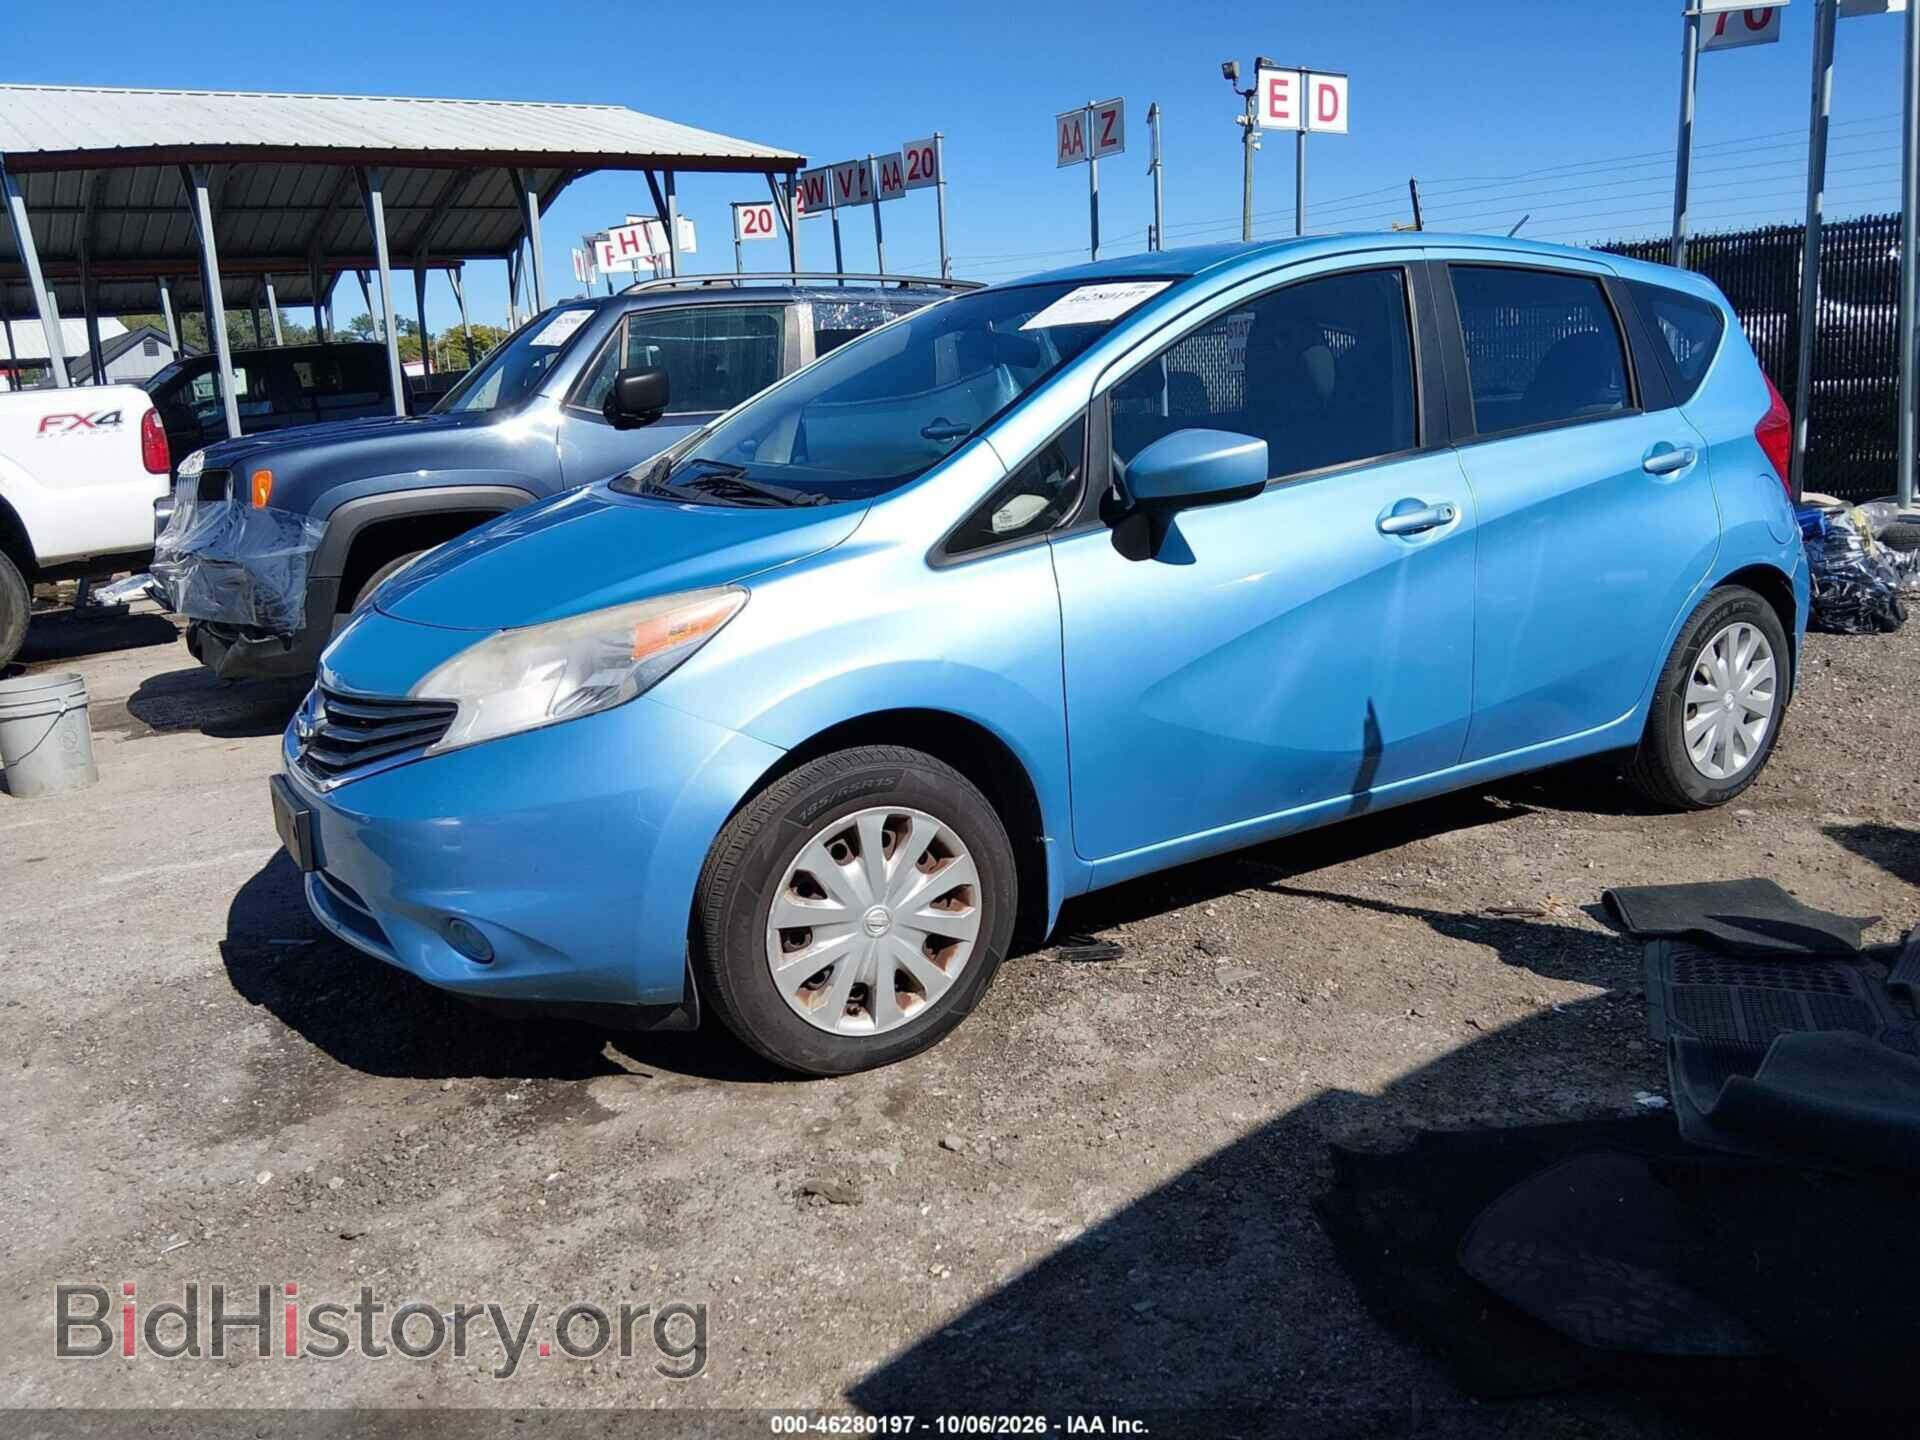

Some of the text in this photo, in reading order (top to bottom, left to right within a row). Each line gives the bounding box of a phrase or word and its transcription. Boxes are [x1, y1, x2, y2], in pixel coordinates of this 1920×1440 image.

[1269, 79, 1289, 118] E
[1318, 84, 1338, 122] D
[1060, 119, 1084, 157] AA
[1101, 110, 1117, 147] Z
[882, 160, 902, 193] AA
[907, 147, 934, 181] 20
[804, 175, 824, 206] W
[838, 168, 853, 198] V
[743, 208, 773, 234] 20
[618, 229, 640, 255] H
[39, 410, 122, 432] FX4
